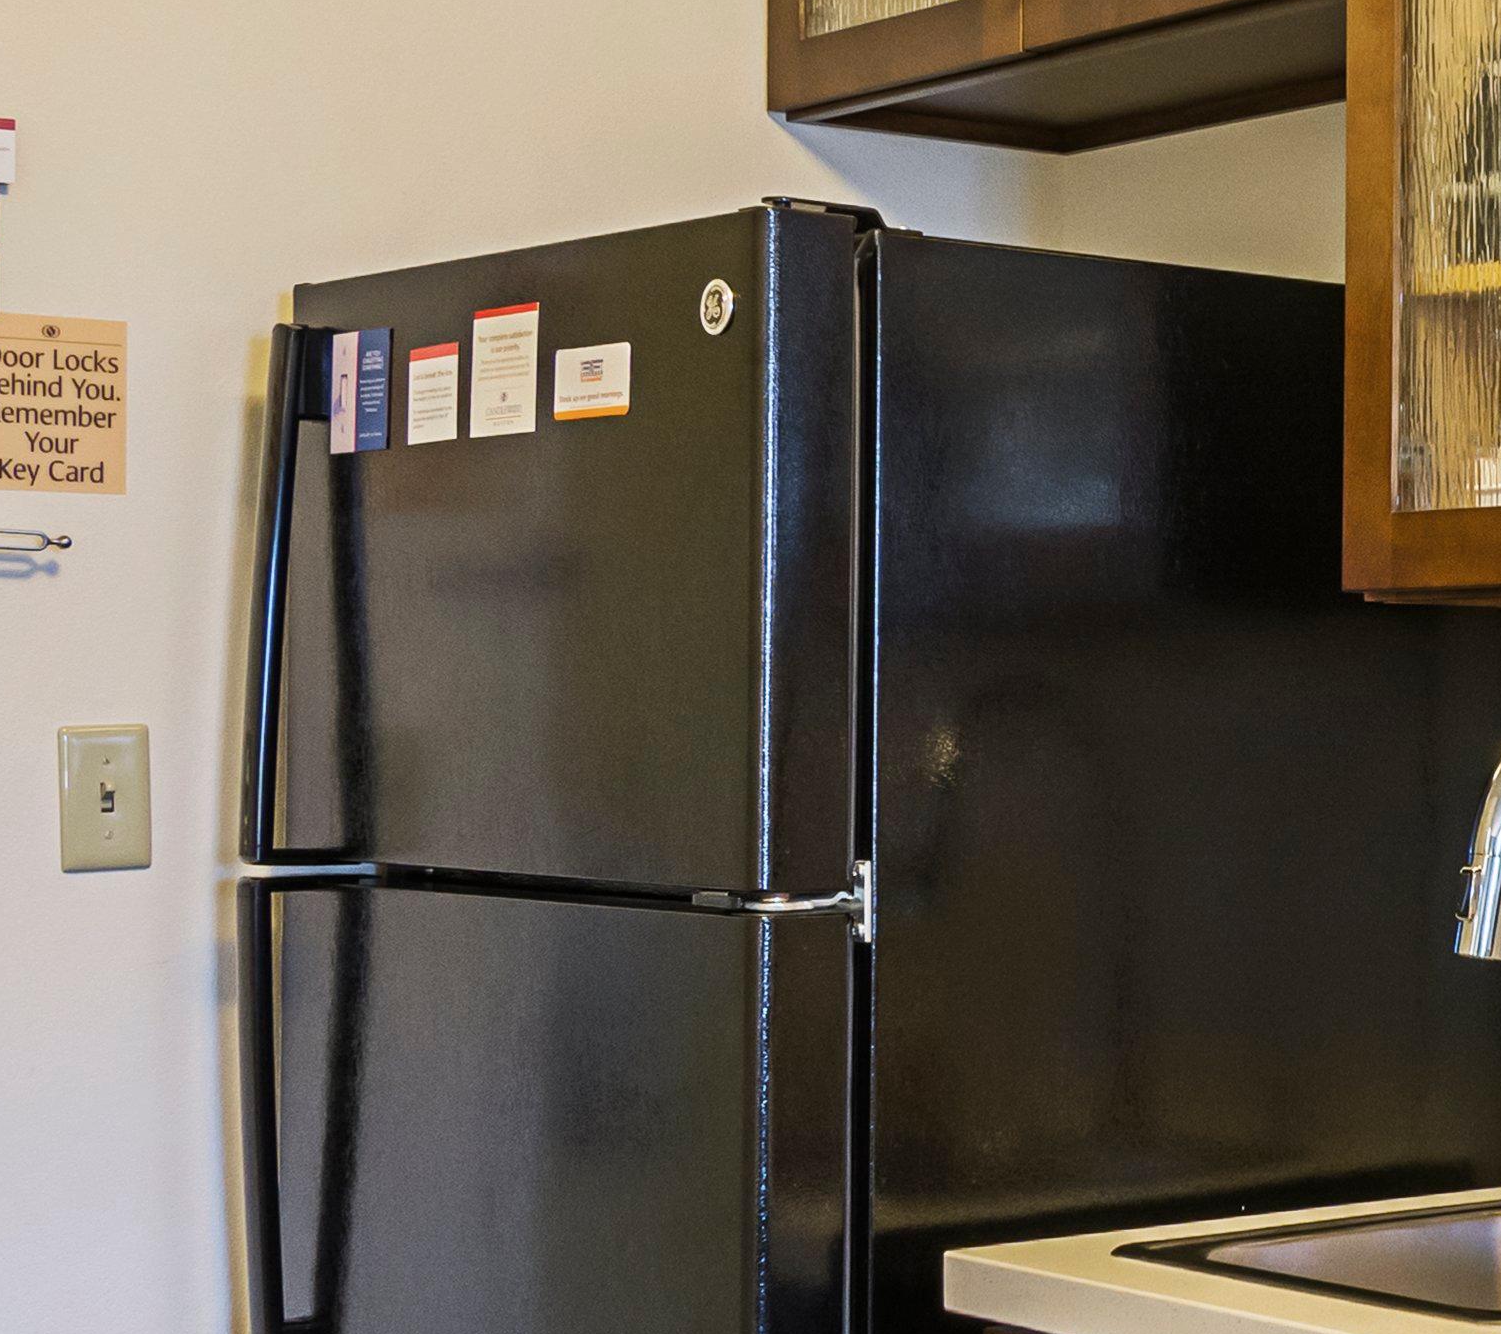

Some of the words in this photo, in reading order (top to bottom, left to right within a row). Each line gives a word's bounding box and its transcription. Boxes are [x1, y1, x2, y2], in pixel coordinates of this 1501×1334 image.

[54, 349, 119, 374] Locks
[72, 378, 121, 401] You.
[25, 431, 79, 454] Your
[49, 460, 104, 483] Card
